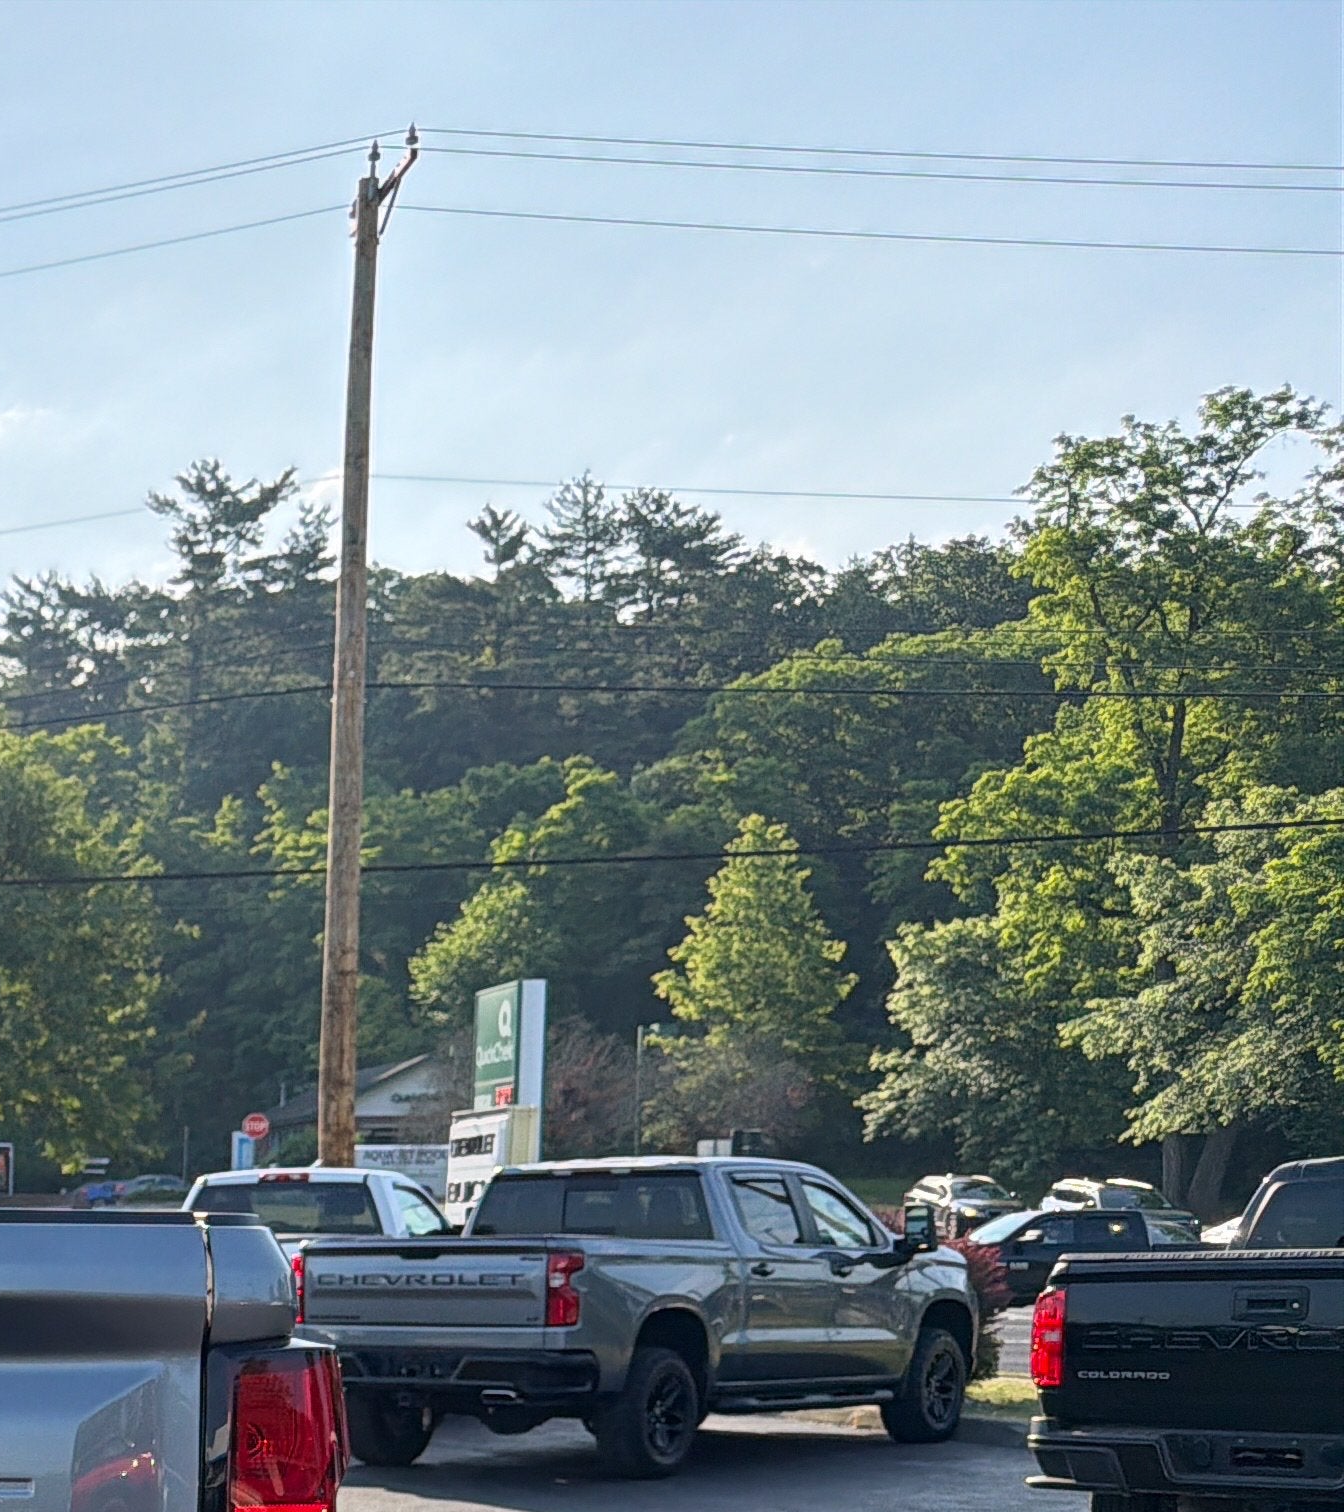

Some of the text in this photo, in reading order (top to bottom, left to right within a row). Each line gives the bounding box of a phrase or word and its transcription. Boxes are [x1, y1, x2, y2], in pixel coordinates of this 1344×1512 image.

[245, 1120, 268, 1132] STOP
[317, 1273, 525, 1287] CHEVROLET
[1077, 1370, 1170, 1381] COLORADO
